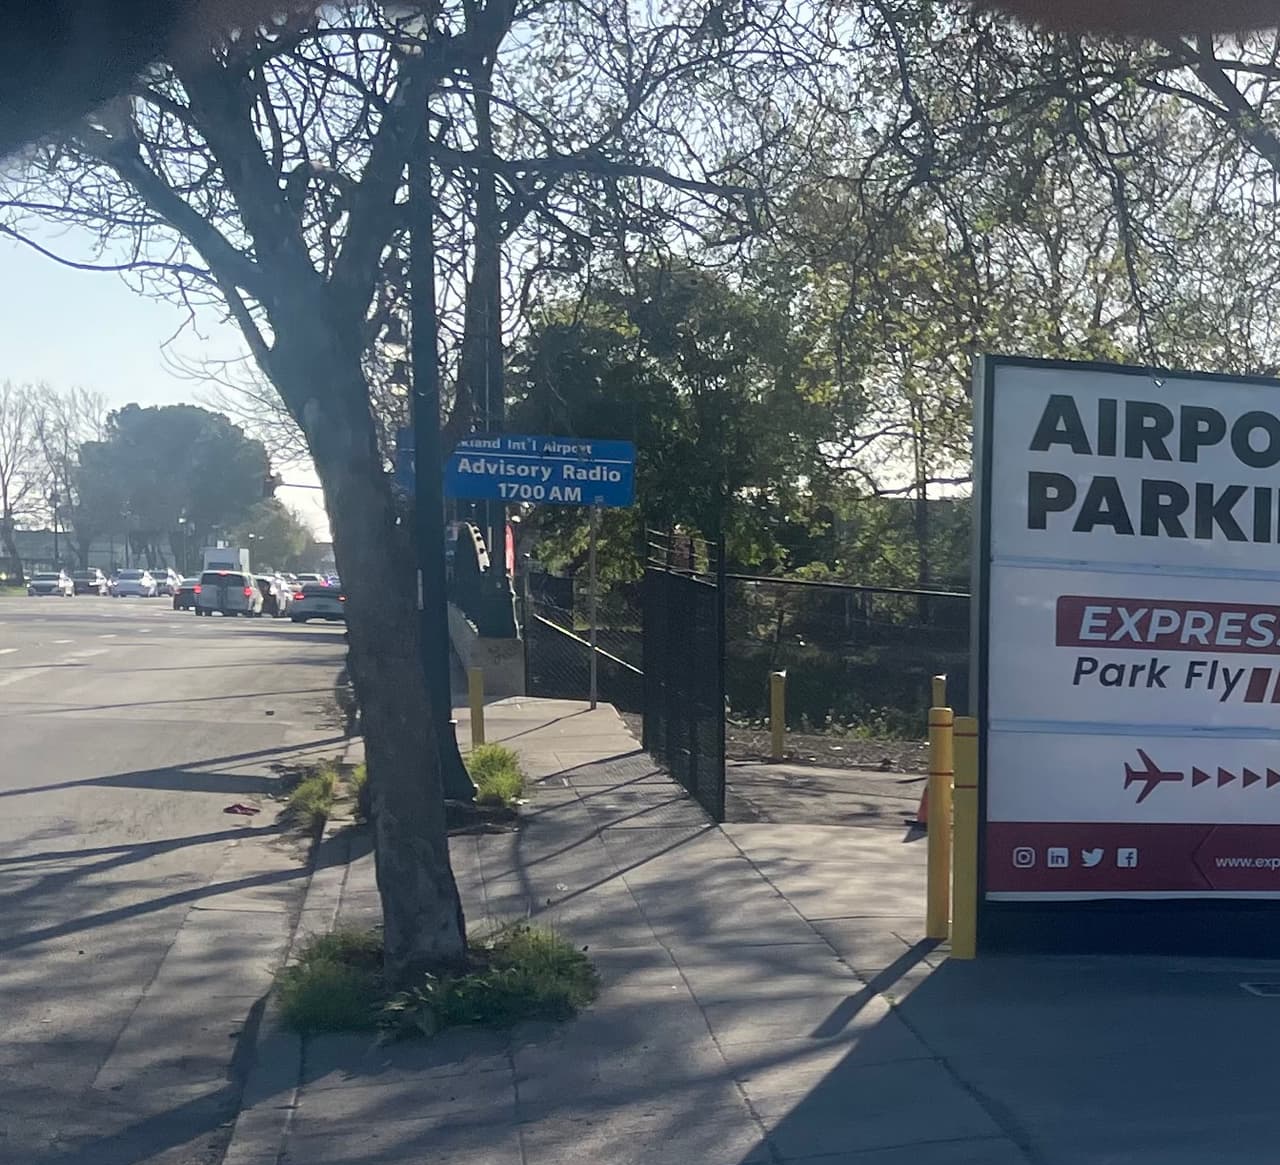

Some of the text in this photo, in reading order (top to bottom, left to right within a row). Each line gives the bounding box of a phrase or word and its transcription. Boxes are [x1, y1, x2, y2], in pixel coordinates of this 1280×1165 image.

[457, 458, 621, 482] Advisory Radio
[498, 483, 582, 502] 1700 AM
[1072, 656, 1246, 702] Park Fly
